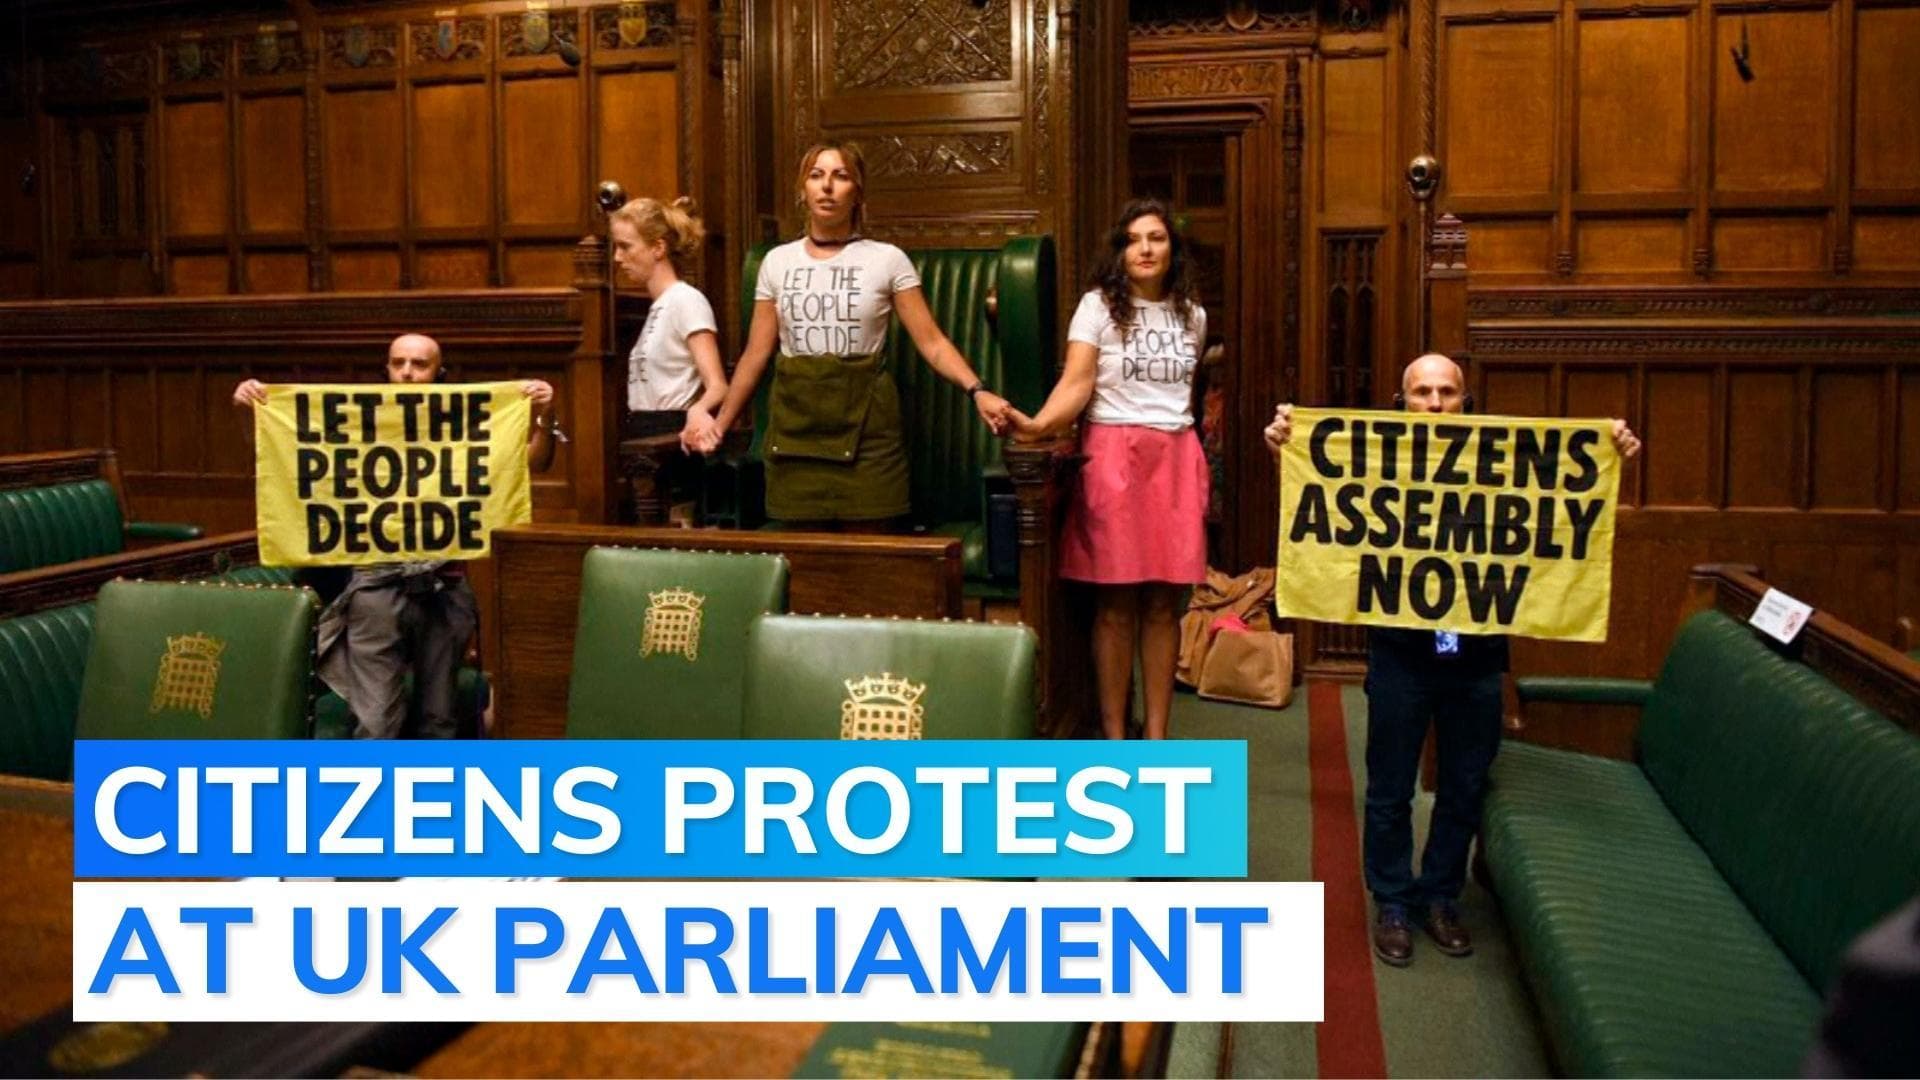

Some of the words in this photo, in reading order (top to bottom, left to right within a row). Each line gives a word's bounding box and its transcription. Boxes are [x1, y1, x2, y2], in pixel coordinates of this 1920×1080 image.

[783, 267, 816, 290] LET
[829, 266, 864, 290] THE
[781, 292, 861, 322] PEOPLE
[1121, 357, 1193, 384] DECIDE
[295, 392, 382, 443] LET
[396, 392, 492, 443] THE
[297, 446, 492, 499] PEOPLE
[1309, 417, 1599, 492] CITIZENS
[306, 501, 484, 554] DECIDE
[1290, 483, 1605, 560] ASSEMBLY
[1357, 554, 1531, 625] NOW
